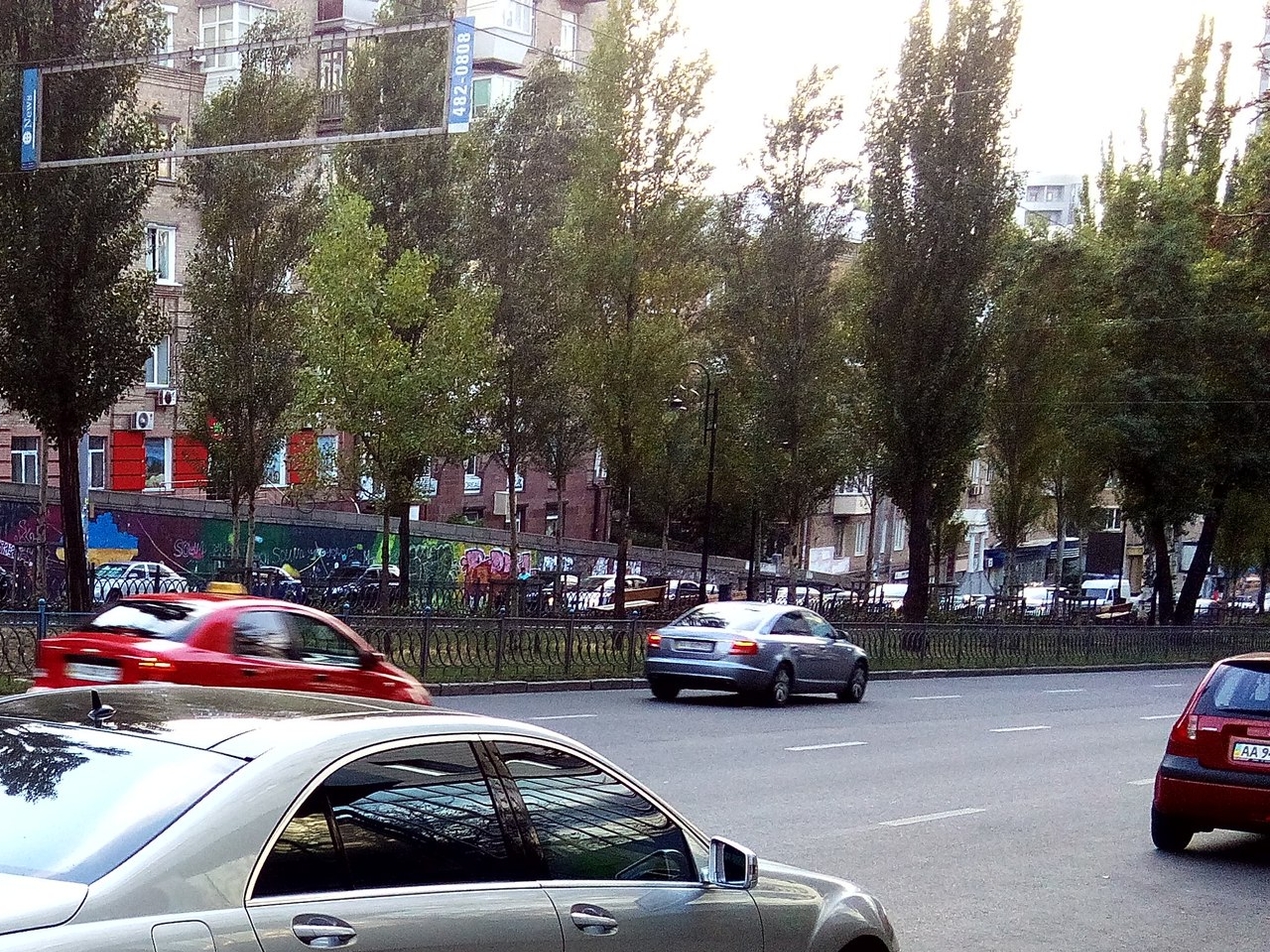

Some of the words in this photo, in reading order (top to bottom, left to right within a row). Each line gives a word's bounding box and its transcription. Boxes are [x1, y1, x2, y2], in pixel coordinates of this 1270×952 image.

[452, 32, 471, 117] 482-0808
[24, 94, 33, 128] News
[1240, 746, 1258, 757] AA
[1261, 748, 1270, 759] 9
